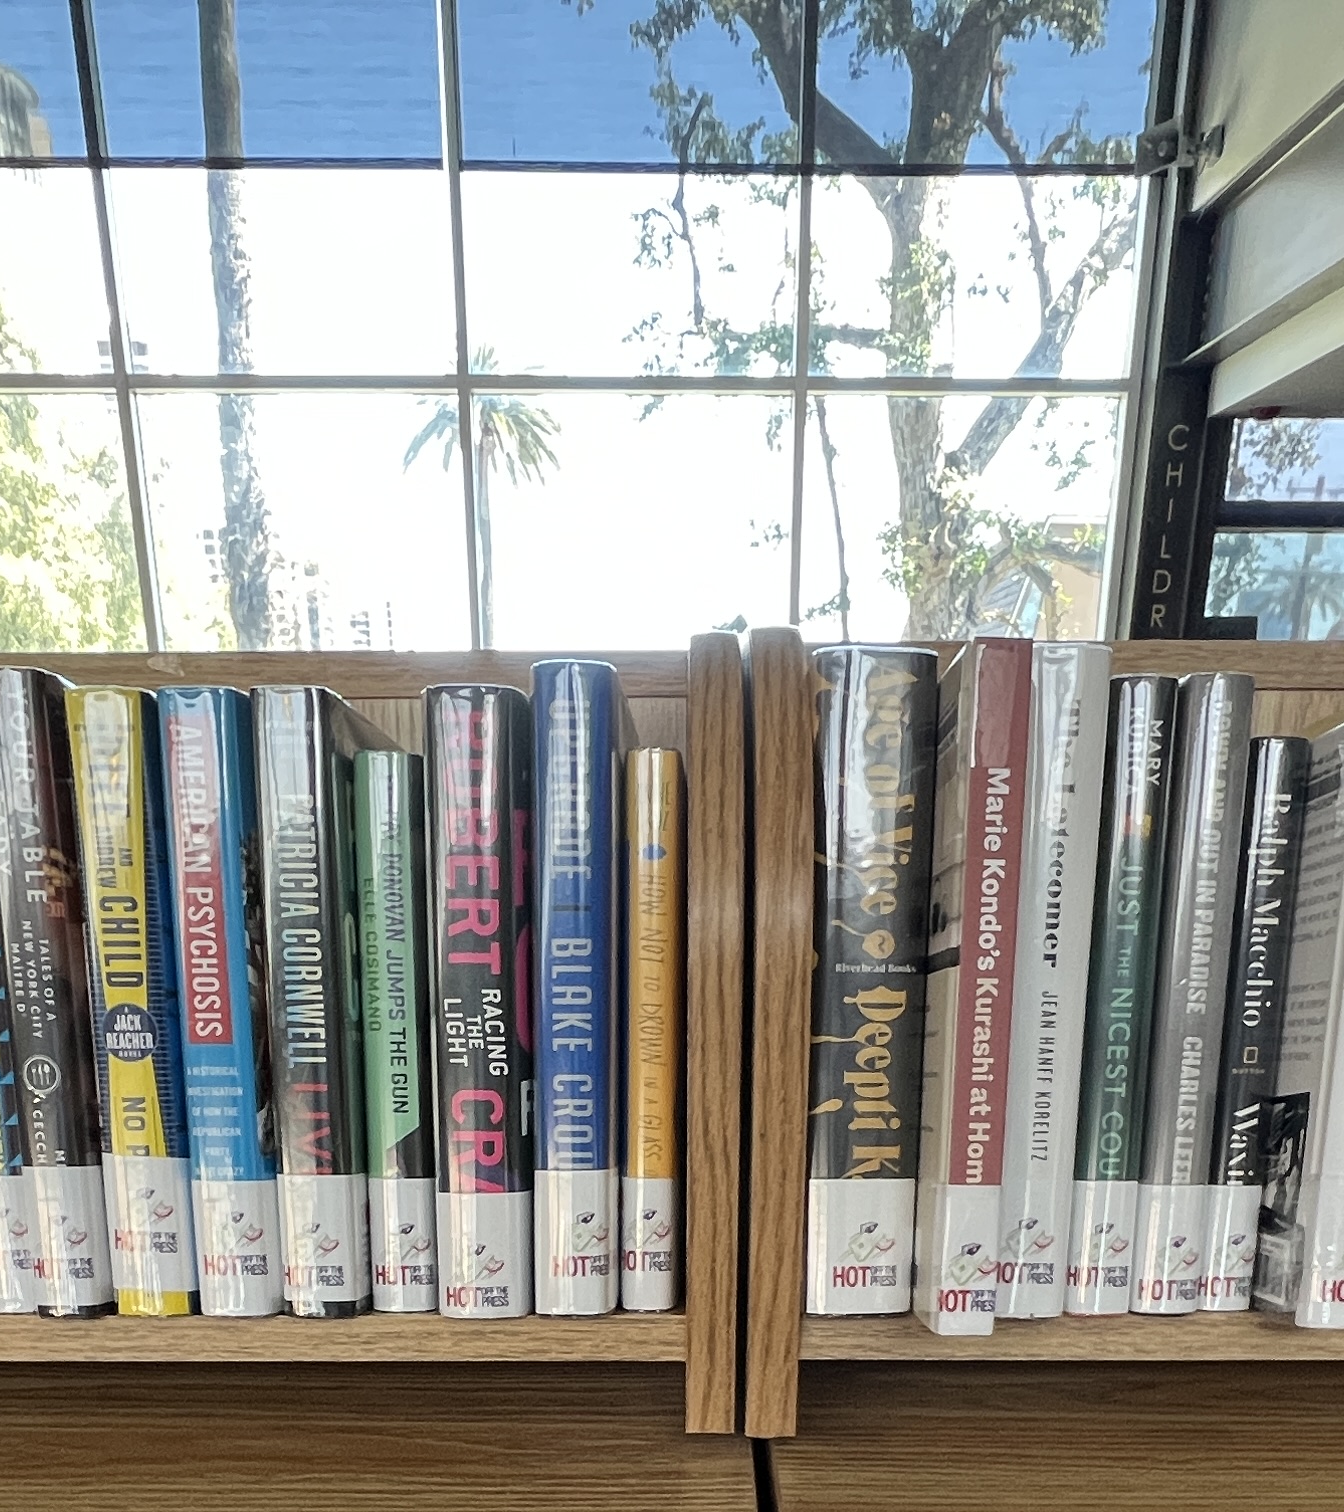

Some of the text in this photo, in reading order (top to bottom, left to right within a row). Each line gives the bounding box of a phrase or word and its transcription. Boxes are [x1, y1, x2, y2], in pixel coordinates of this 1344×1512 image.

[1149, 424, 1190, 629] CHILDR
[100, 896, 145, 988] CHILD
[186, 886, 223, 1038] PSYCHOSIS
[278, 798, 326, 1068] PATRICIA CORNWELL
[968, 767, 1010, 1115] Marie Kurashi at
[1242, 900, 1281, 1026] Macchio
[107, 1034, 151, 1049] REACHER
[114, 1014, 143, 1031] JACK
[386, 949, 409, 1114] JUMPS THE GUN
[443, 989, 508, 1076] RACING THE LIGHT
[551, 938, 593, 1053] BLAKE
[1106, 988, 1131, 1099] NICEST
[843, 987, 907, 1130] Deepti
[1030, 991, 1057, 1163] JEAN HANFF KORELITZ
[205, 1255, 240, 1276] HOT
[447, 1286, 483, 1307] HOT
[832, 1265, 870, 1287] HOT
